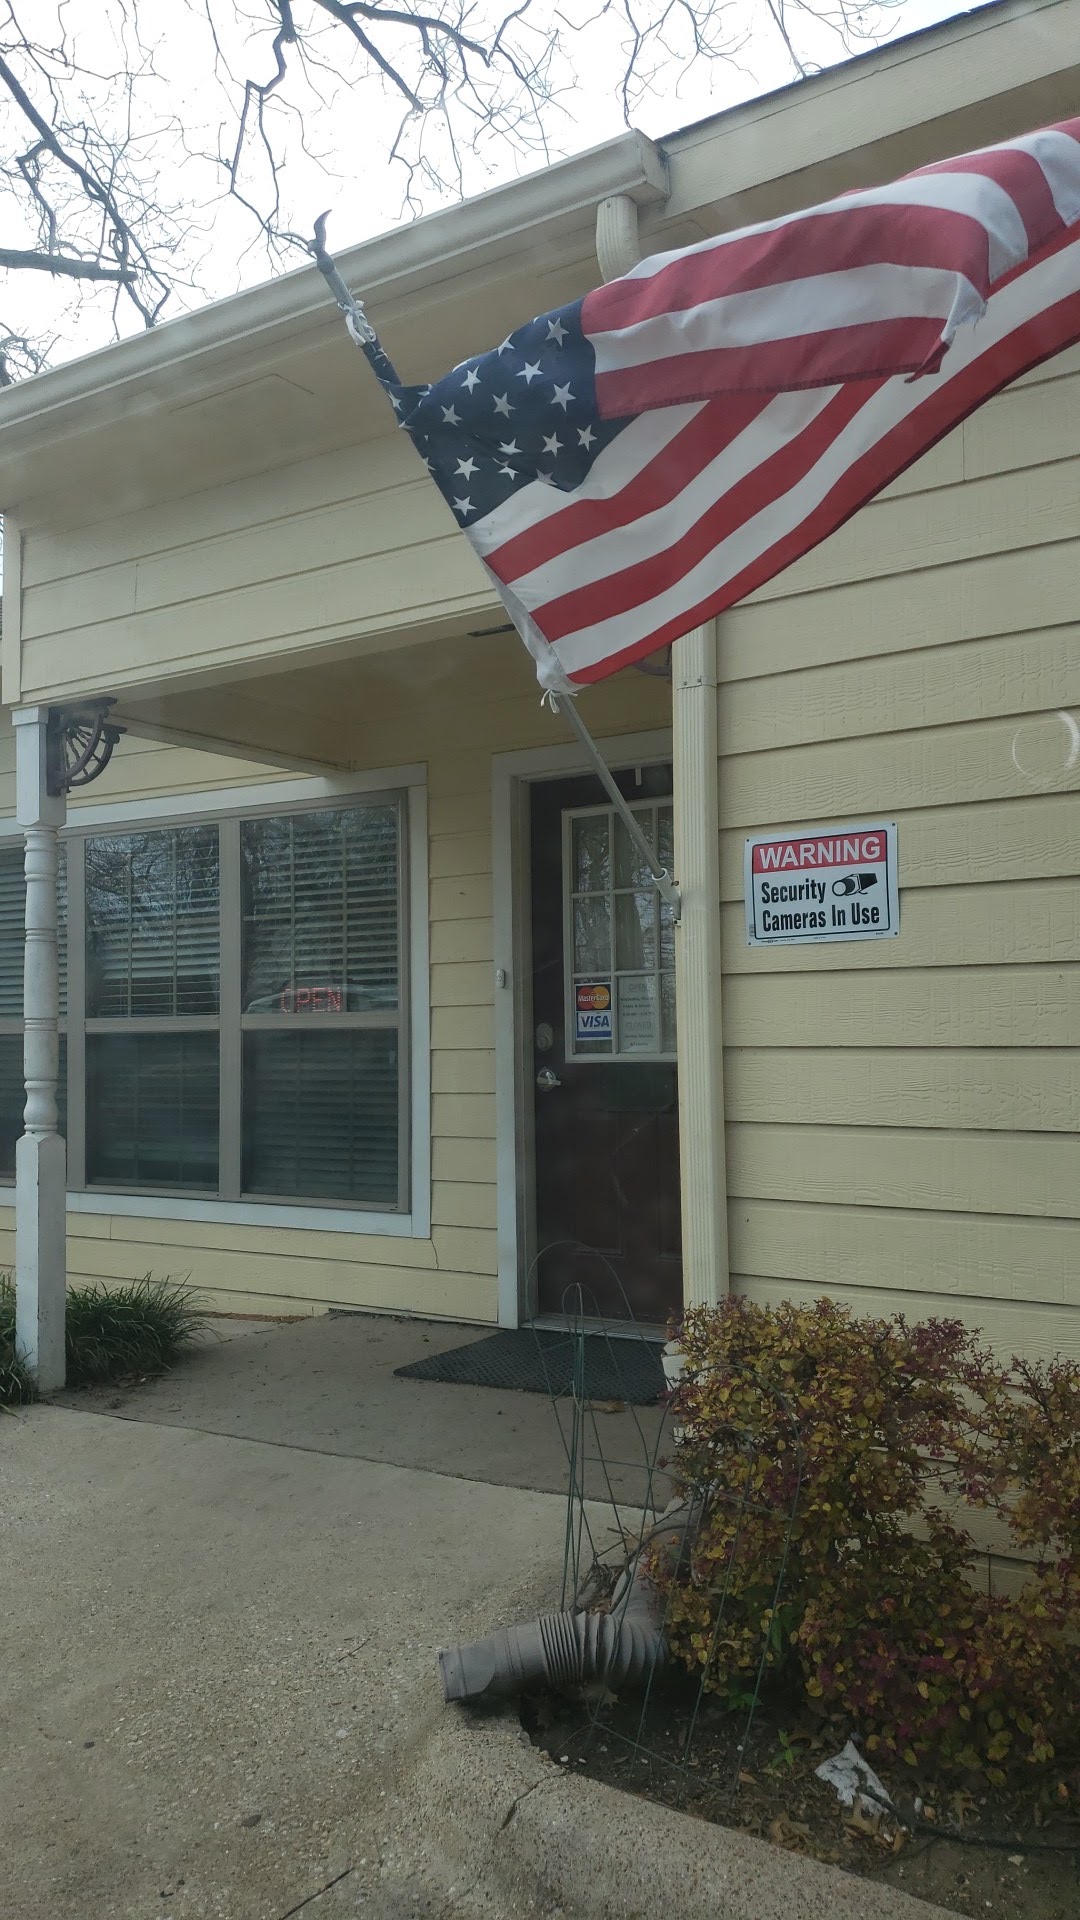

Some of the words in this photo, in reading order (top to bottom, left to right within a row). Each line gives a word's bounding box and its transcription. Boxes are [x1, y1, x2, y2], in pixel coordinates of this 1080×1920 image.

[760, 836, 880, 869] WARNING
[761, 878, 827, 904] Security
[762, 909, 826, 932] Cameras
[832, 904, 846, 926] In
[851, 902, 880, 925] Use
[280, 986, 341, 1013] OPEN
[578, 994, 609, 1002] MasterCard
[581, 1015, 610, 1028] VISA
